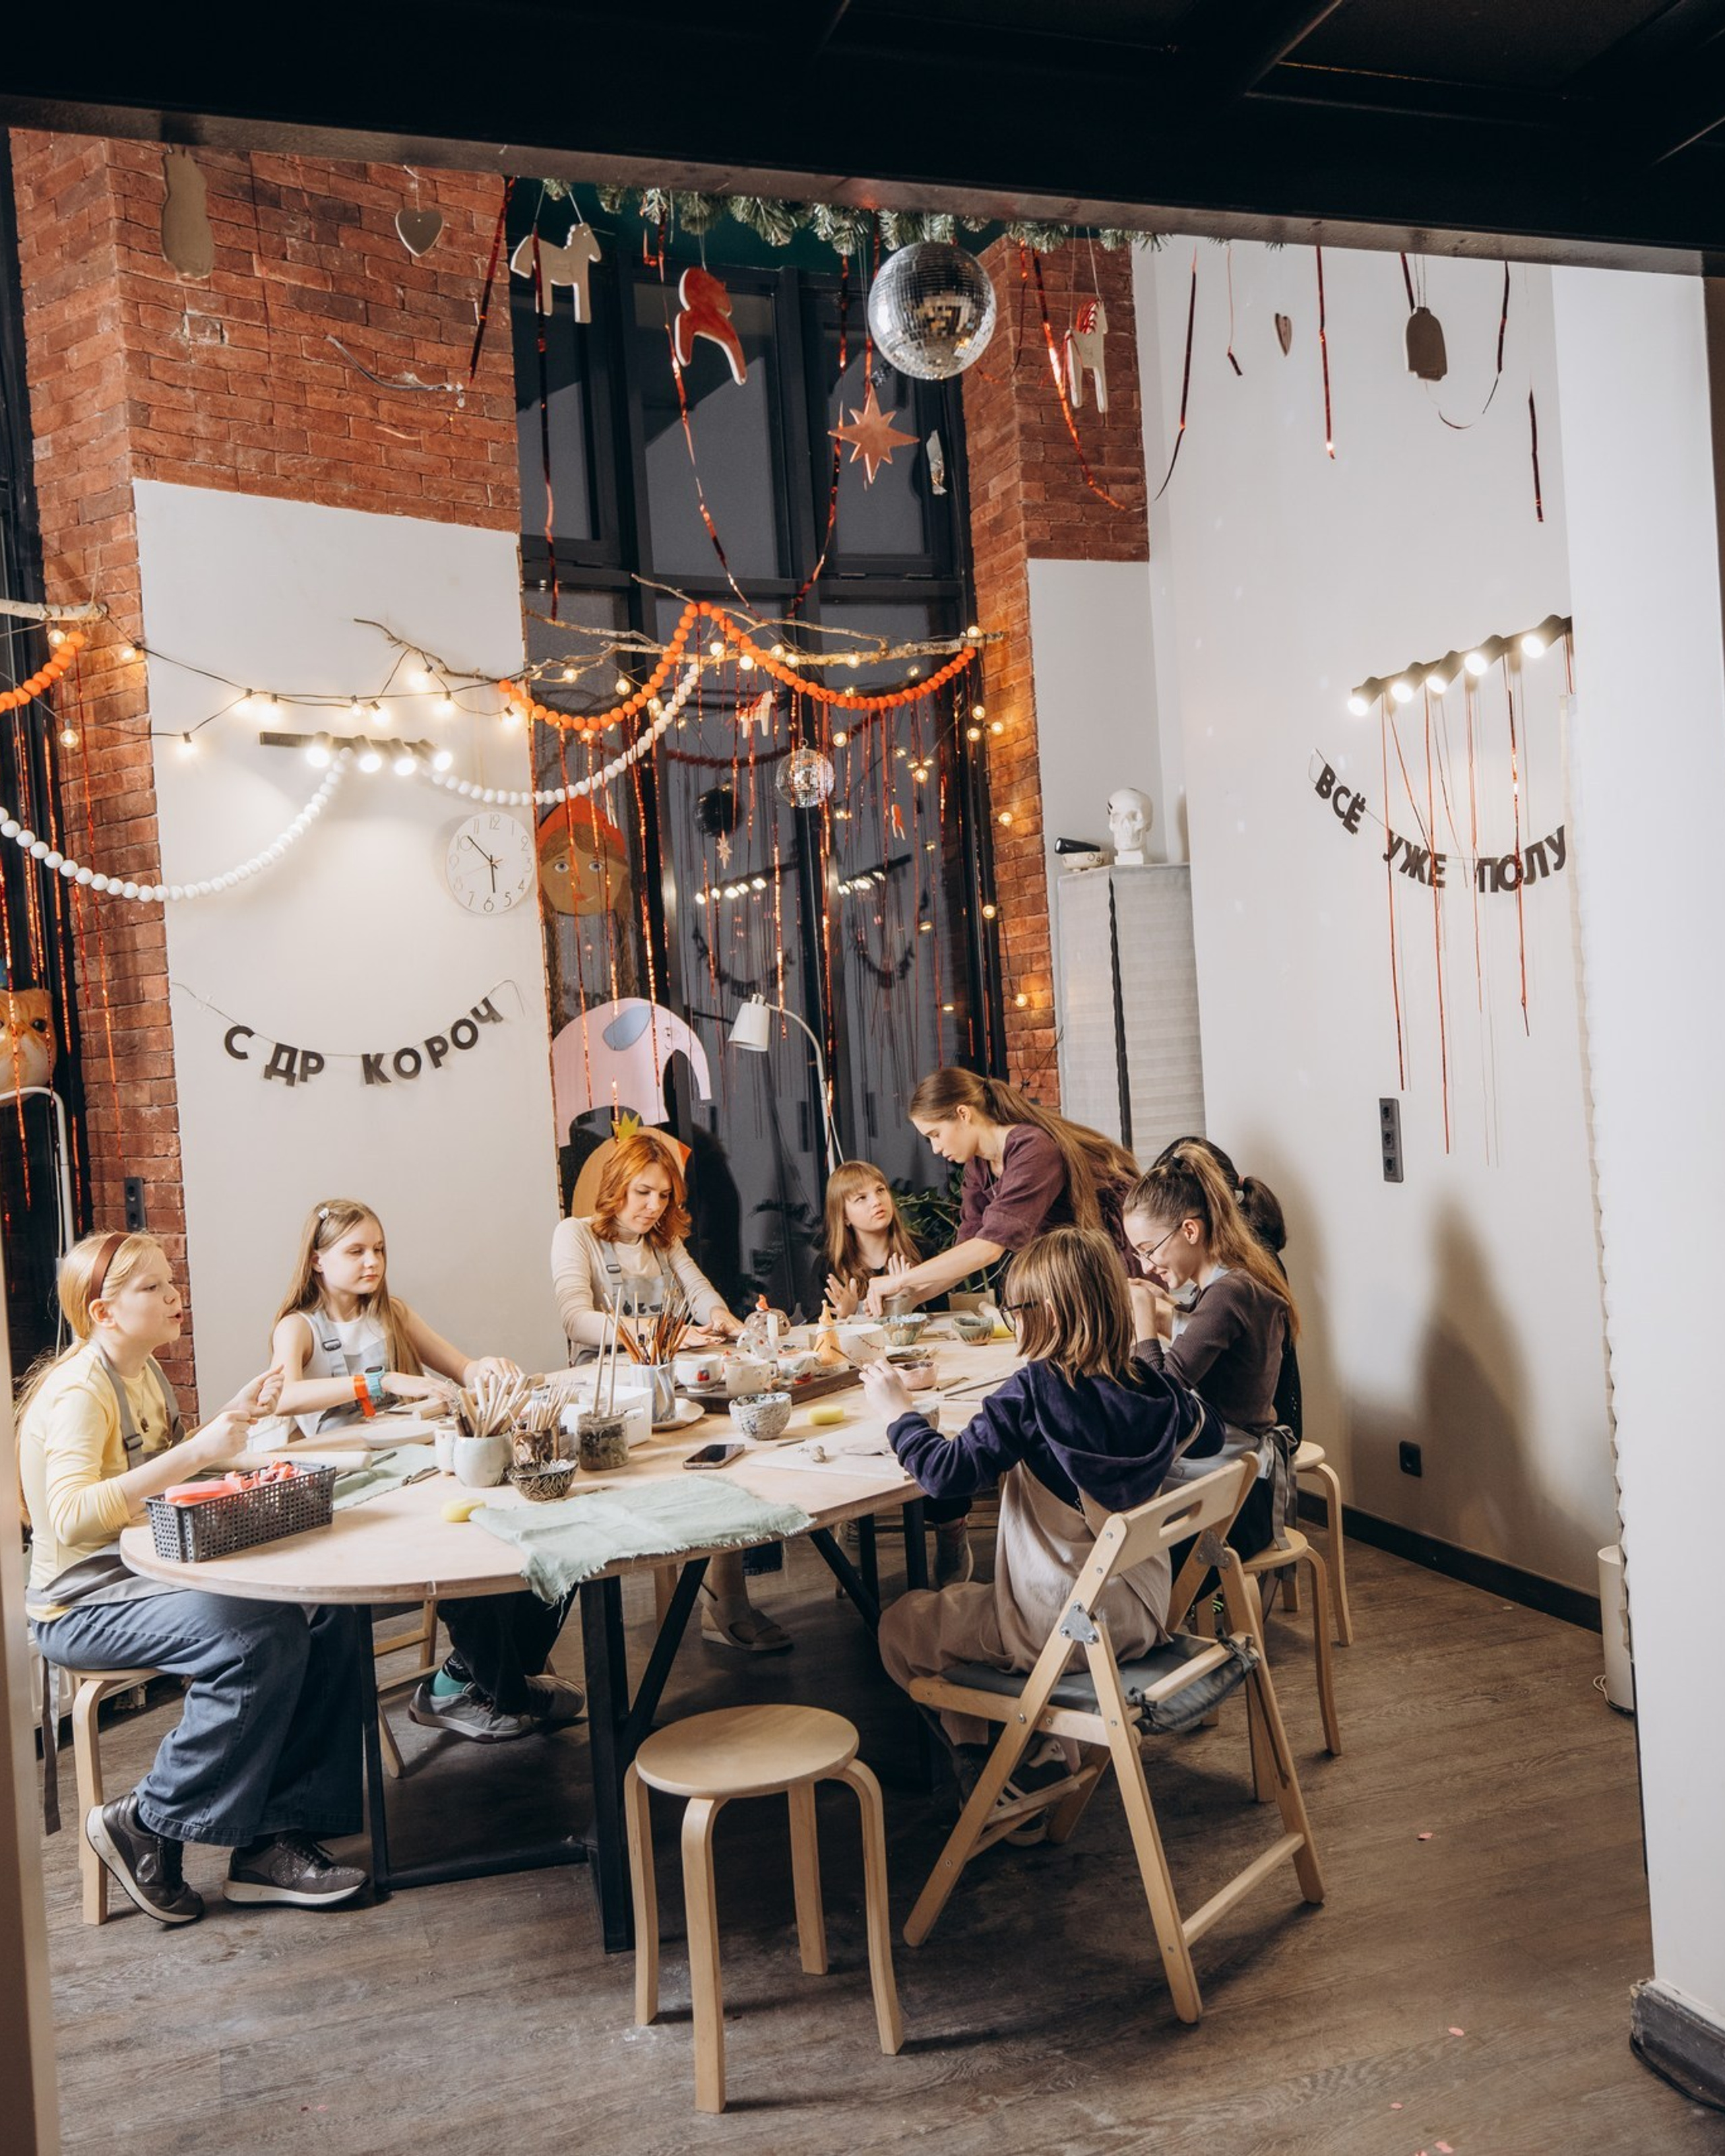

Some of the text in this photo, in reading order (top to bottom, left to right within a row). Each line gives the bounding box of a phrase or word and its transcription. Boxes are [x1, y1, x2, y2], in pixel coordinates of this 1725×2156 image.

[473, 819, 480, 835] 11
[489, 814, 501, 830] 12
[511, 820, 515, 836] 1
[1315, 763, 1567, 893] ВСЁ УЖЕ ПОЛУ
[456, 835, 473, 852] 10
[520, 835, 528, 852] 2
[449, 854, 460, 871] 9
[524, 857, 533, 873] 3
[518, 879, 524, 893] 4
[468, 891, 474, 907] 7
[483, 897, 495, 912] 6
[504, 892, 512, 908] 5
[224, 996, 503, 1087] С ДР КОРОЧ
